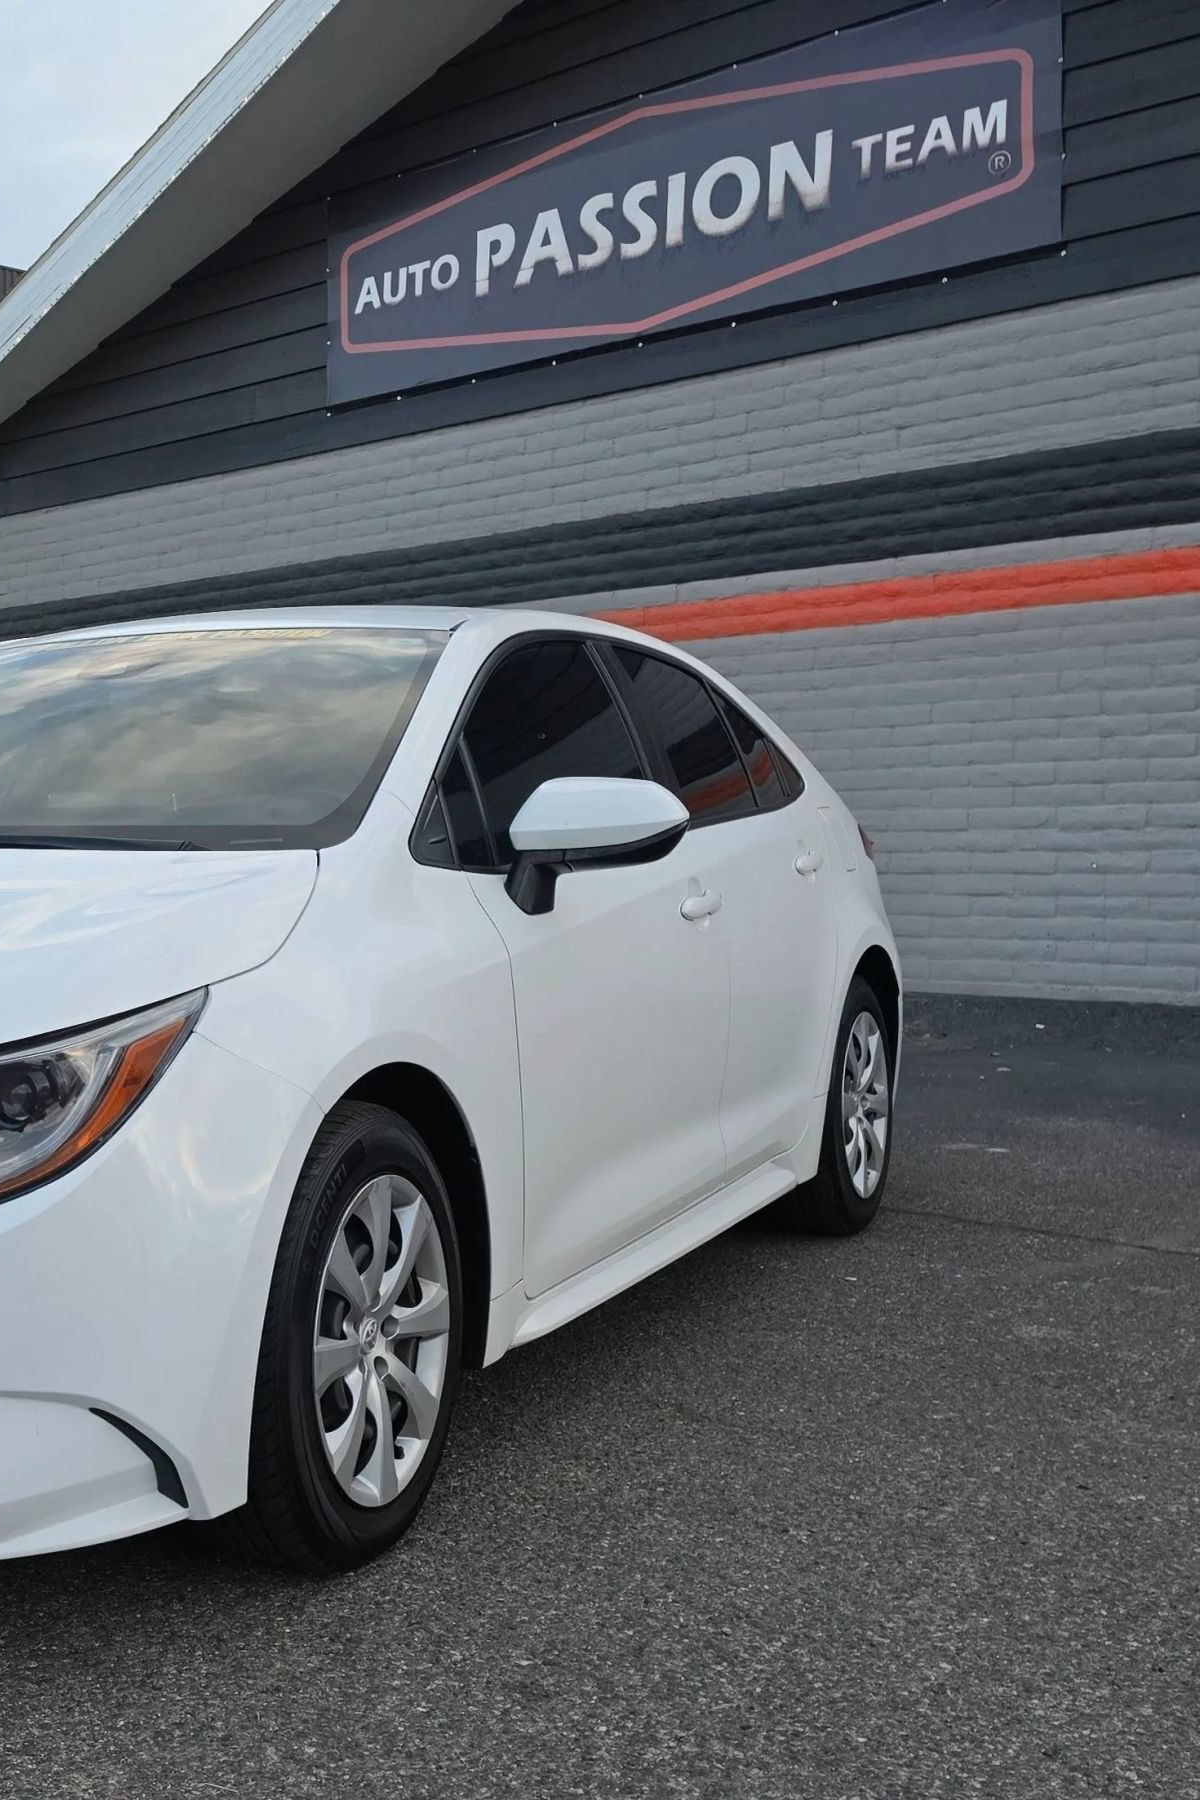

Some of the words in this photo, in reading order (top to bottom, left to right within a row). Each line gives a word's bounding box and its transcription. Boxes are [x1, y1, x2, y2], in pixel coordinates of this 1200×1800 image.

[353, 252, 461, 315] AUTO
[473, 128, 834, 298] PASSION
[851, 98, 1009, 180] TEAM
